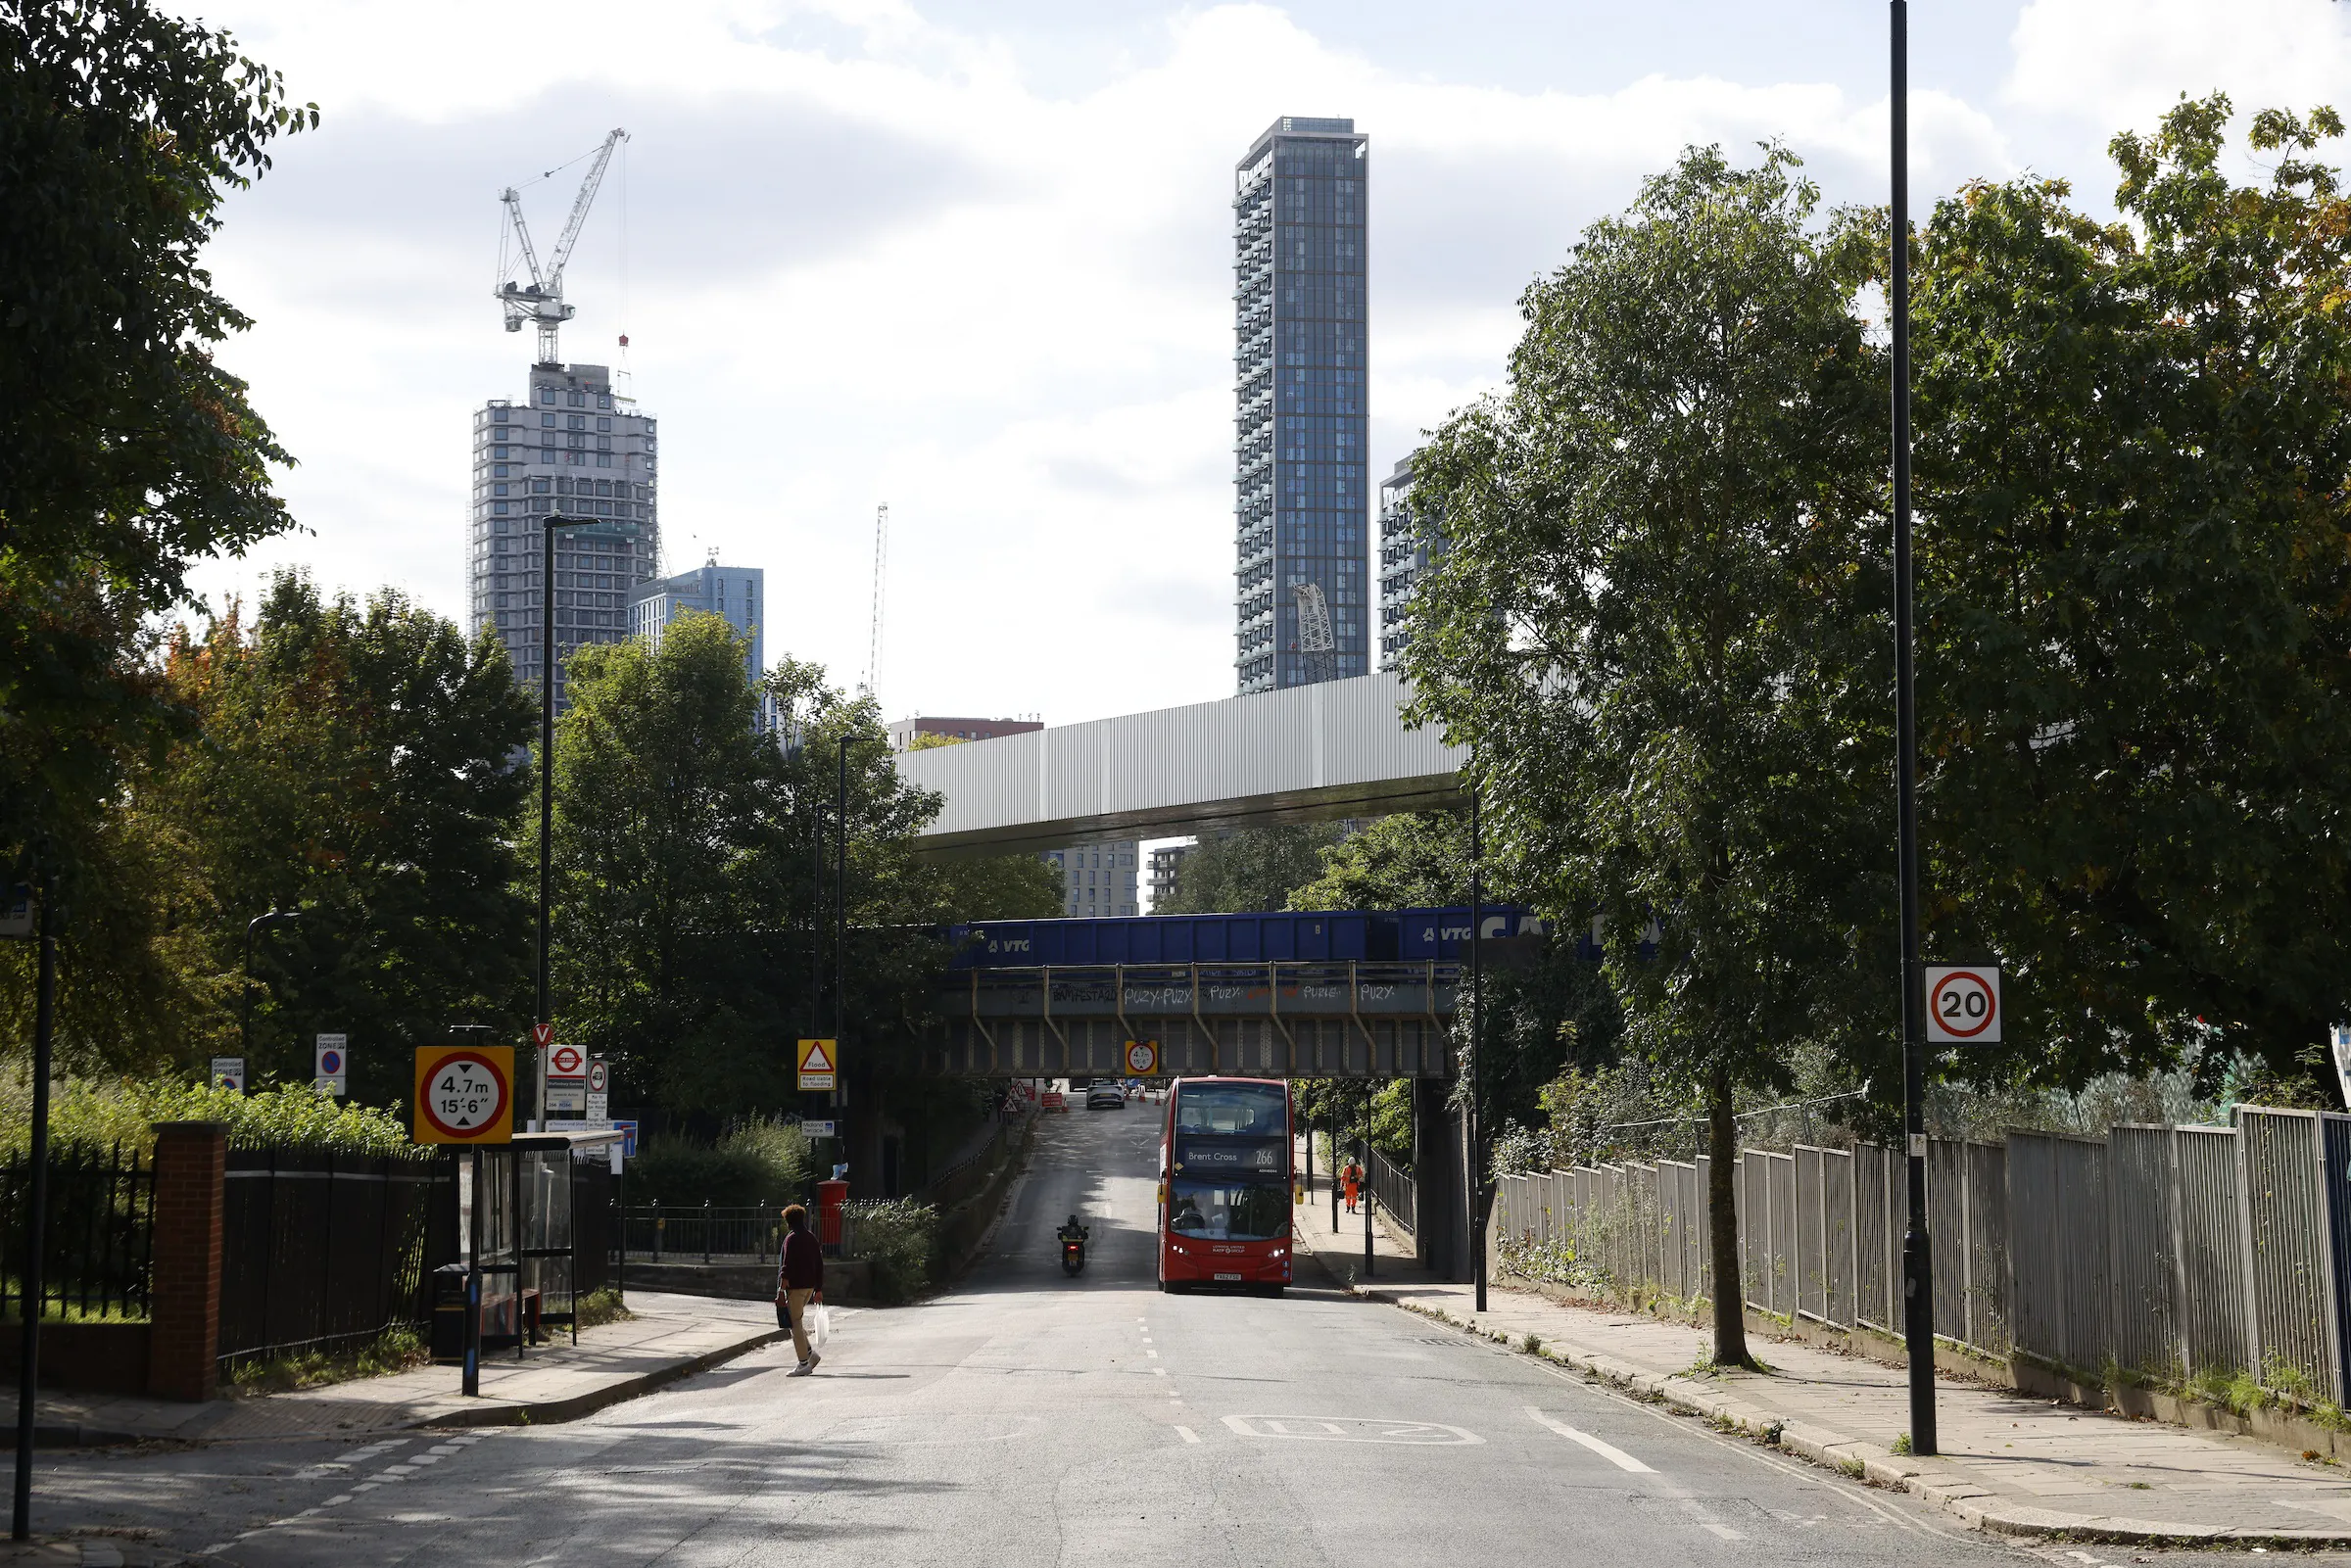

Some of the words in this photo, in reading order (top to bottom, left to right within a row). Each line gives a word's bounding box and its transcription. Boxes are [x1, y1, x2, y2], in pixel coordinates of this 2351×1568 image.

[1440, 927, 1472, 940] VTG
[1003, 939, 1030, 952] VTG
[1942, 991, 1987, 1018] 20
[536, 1026, 548, 1042] V
[1188, 1152, 1211, 1161] Brent
[1214, 1152, 1237, 1162] Cross
[1256, 1150, 1273, 1164] 266
